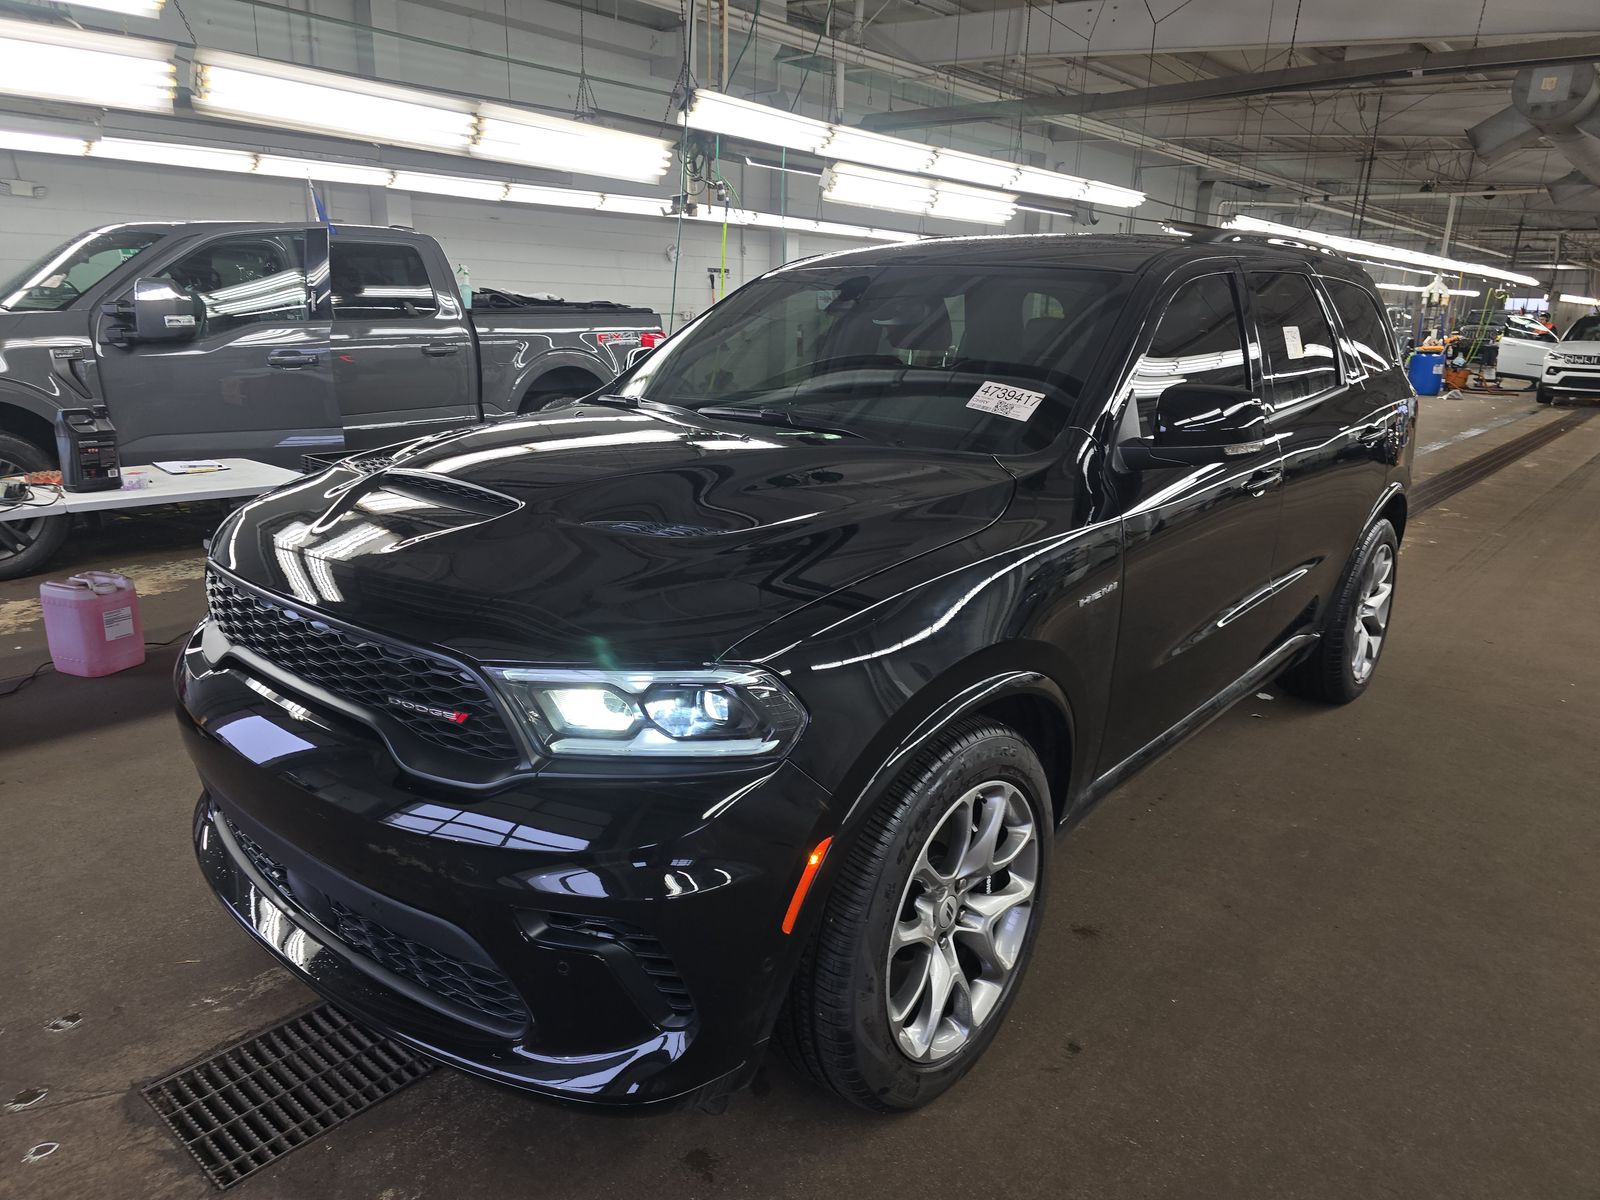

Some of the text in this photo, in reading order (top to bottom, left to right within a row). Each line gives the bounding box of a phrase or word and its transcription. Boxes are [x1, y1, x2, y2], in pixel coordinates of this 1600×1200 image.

[597, 332, 634, 346] FX4
[981, 385, 1044, 407] 4739417
[1078, 581, 1119, 607] HEMI
[388, 696, 457, 721] DODGE
